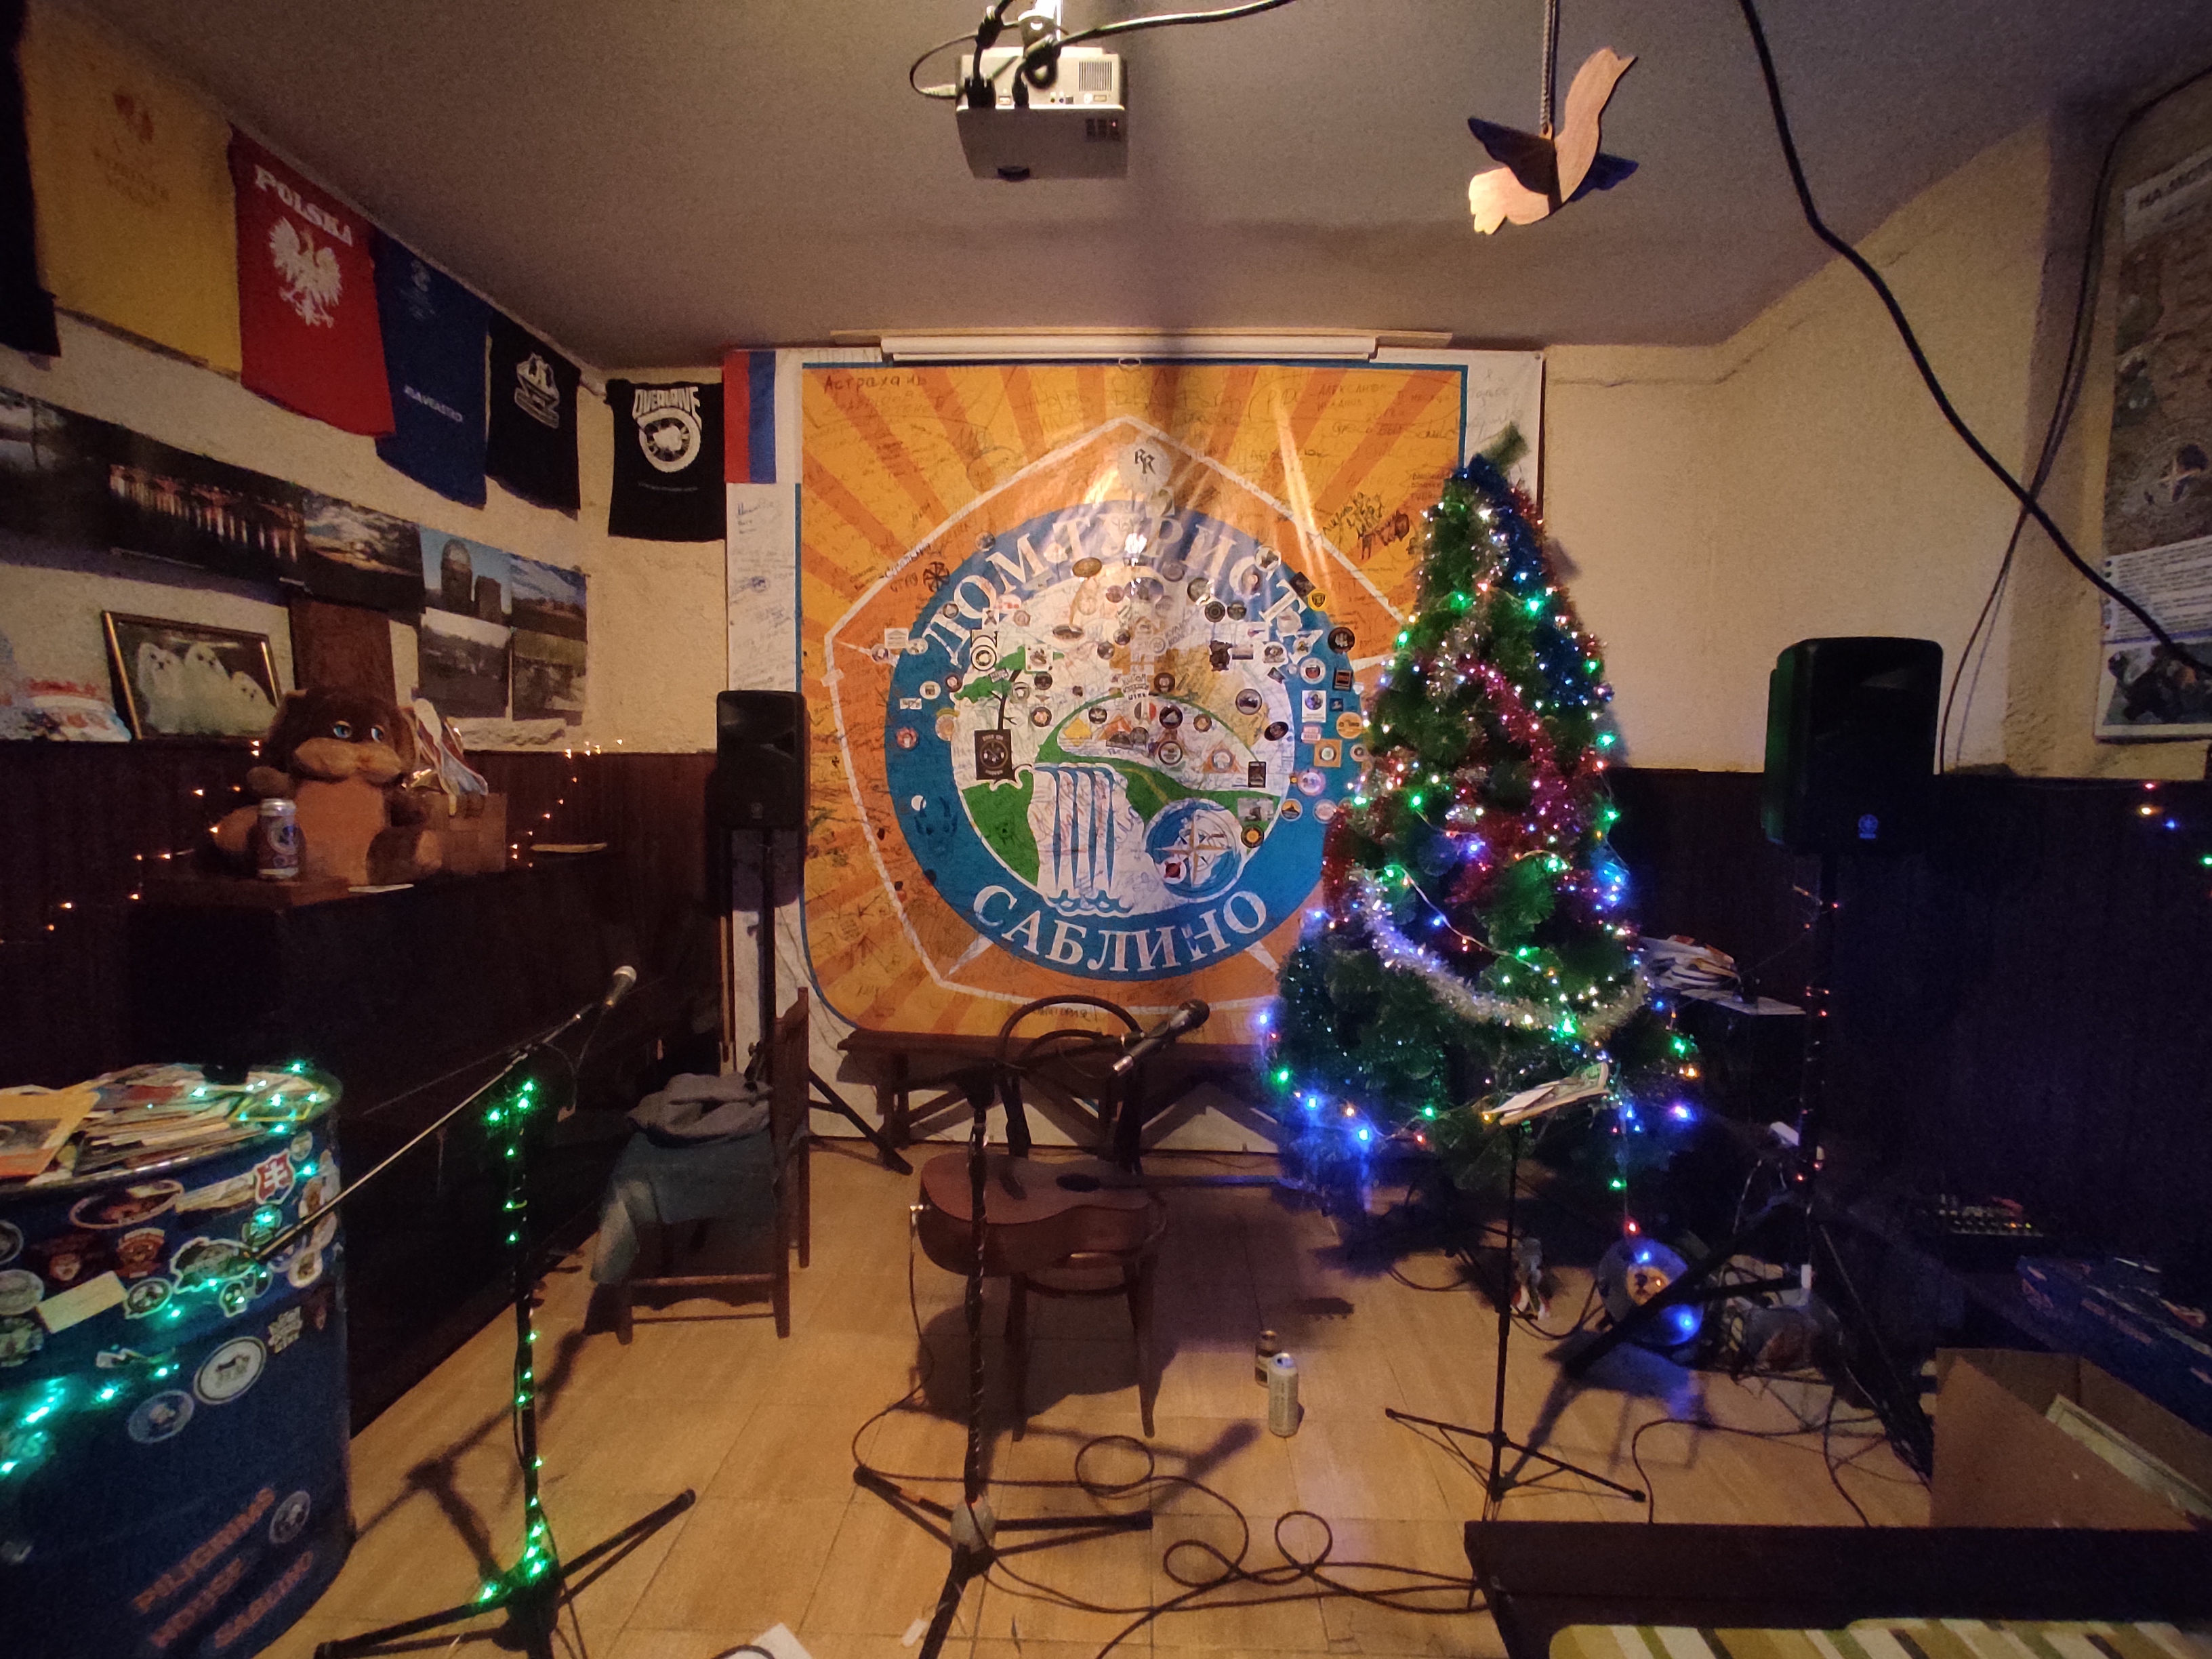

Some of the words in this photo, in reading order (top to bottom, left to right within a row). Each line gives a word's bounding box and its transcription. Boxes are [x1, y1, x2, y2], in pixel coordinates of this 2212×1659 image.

[254, 164, 353, 247] POLSKA
[632, 386, 702, 430] OVERDRIVE
[823, 374, 927, 394] Астрахань
[972, 884, 1267, 972] САБЛИНО
